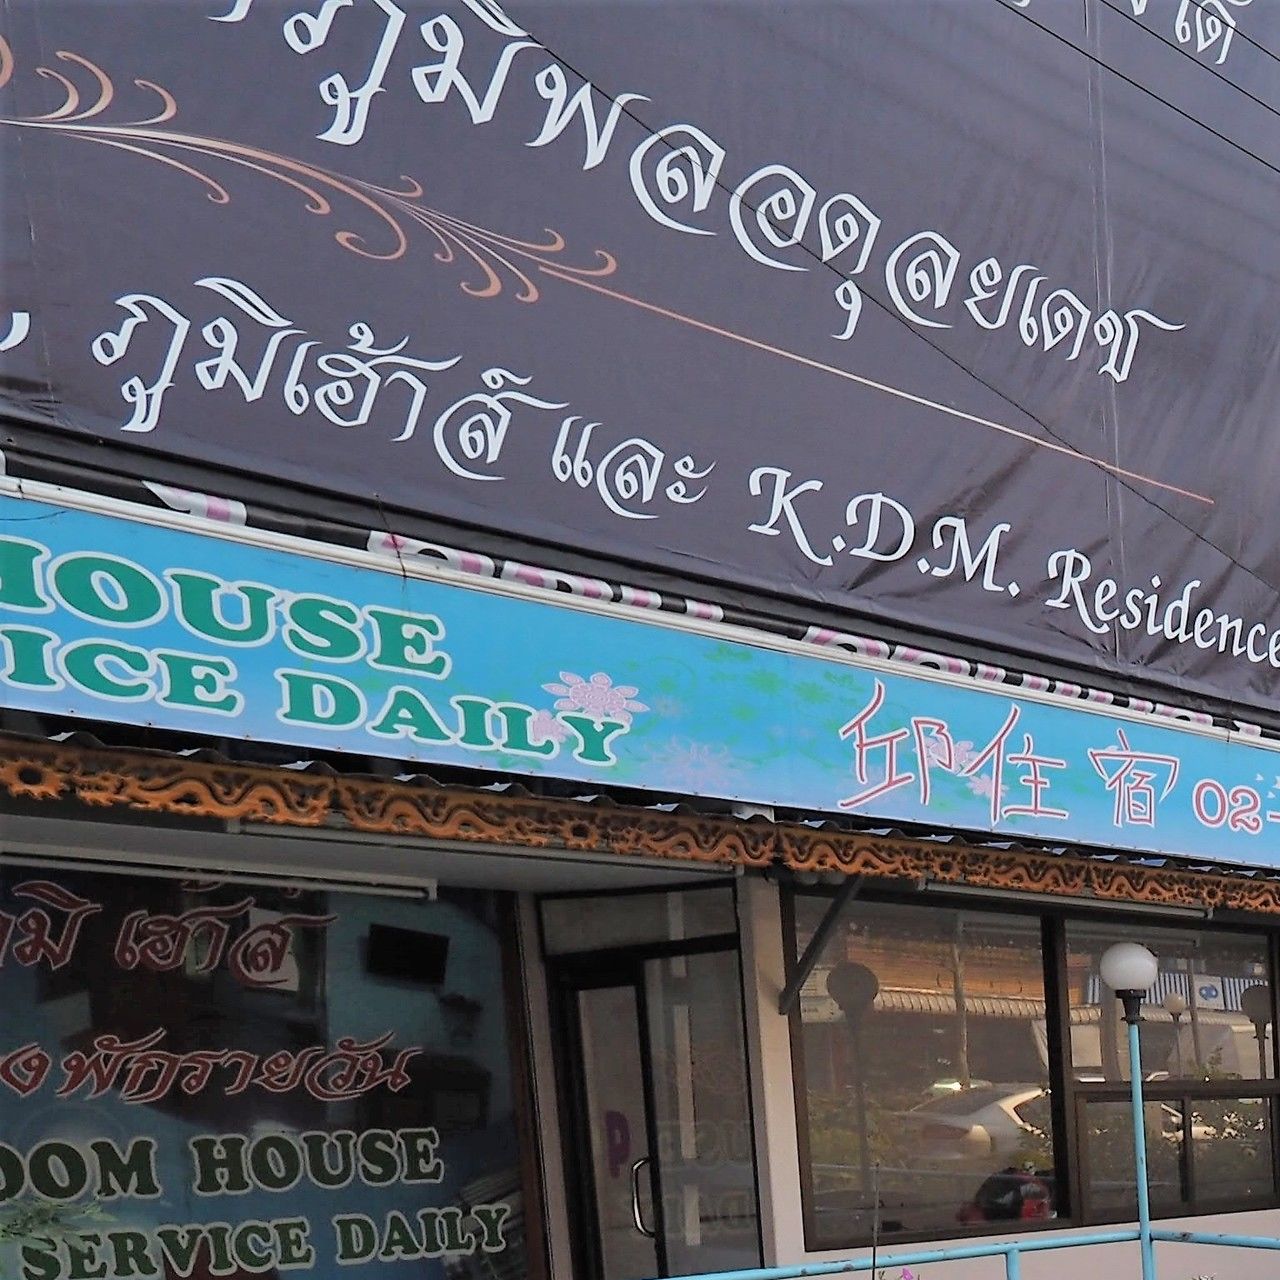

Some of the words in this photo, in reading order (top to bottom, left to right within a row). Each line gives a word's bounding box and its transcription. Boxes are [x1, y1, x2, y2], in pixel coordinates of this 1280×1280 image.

[208, 0, 1186, 382] ภูมิพลอดุลยเดช
[748, 466, 1021, 599] K.D.M.
[275, 666, 632, 768] DAILY
[189, 1126, 445, 1198] HOUSE
[333, 1204, 511, 1268] DAILY
